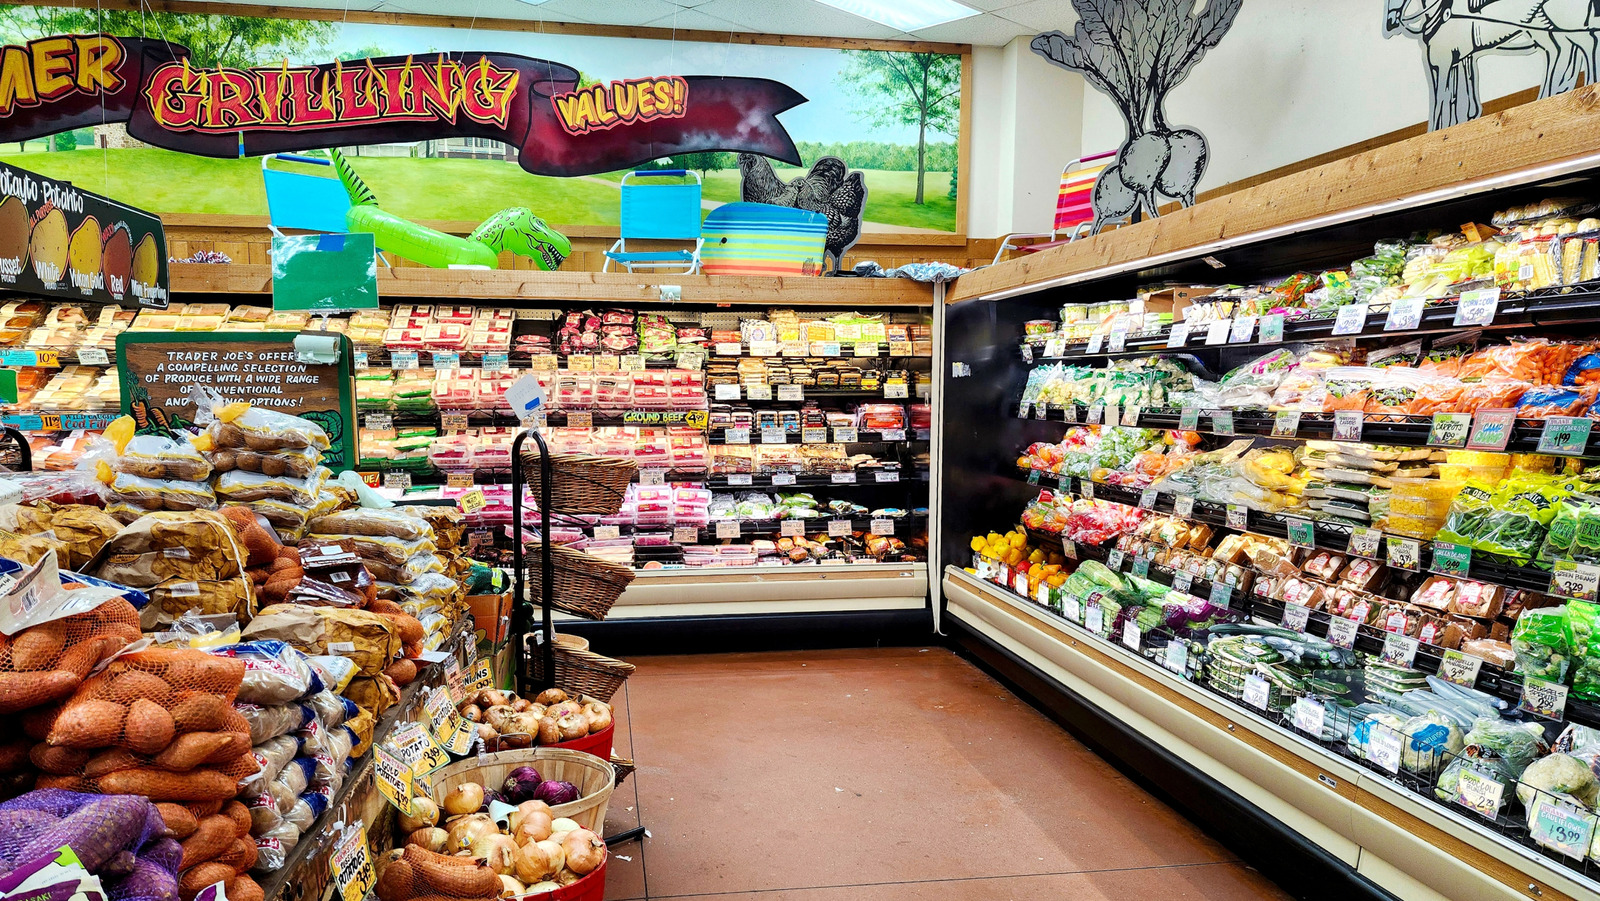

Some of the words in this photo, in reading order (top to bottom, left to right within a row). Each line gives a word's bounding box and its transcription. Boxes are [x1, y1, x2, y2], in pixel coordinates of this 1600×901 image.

[145, 57, 519, 130] GRILLING
[556, 78, 687, 131] VALUES!
[0, 167, 38, 205] otayto
[41, 181, 84, 213] Potahto
[0, 256, 22, 275] usset
[110, 275, 124, 293] Red
[167, 351, 218, 361] TRADER
[223, 351, 254, 361] JOE'S
[259, 352, 301, 361] OFFER
[157, 362, 165, 372] A
[168, 362, 239, 372] COMPELLING
[243, 363, 307, 373] SELECTION
[145, 374, 160, 383] OF
[165, 374, 212, 384] PRODUCE
[217, 374, 242, 383] WITH
[246, 374, 253, 383] A
[256, 374, 281, 384] WIDE
[286, 374, 320, 384] RANGE
[180, 385, 194, 394] OF
[201, 385, 284, 395] CNVENTIONAL
[165, 397, 189, 407] AND
[624, 412, 660, 422] GROUND
[663, 412, 684, 422] BEEF
[65, 420, 86, 429] Cod
[1436, 423, 1464, 431] CARROTS
[381, 760, 400, 777] GOLD
[376, 763, 406, 793] POTATOES
[1541, 811, 1586, 835] CAULIFLOWER
[338, 845, 365, 888] POTATOES
